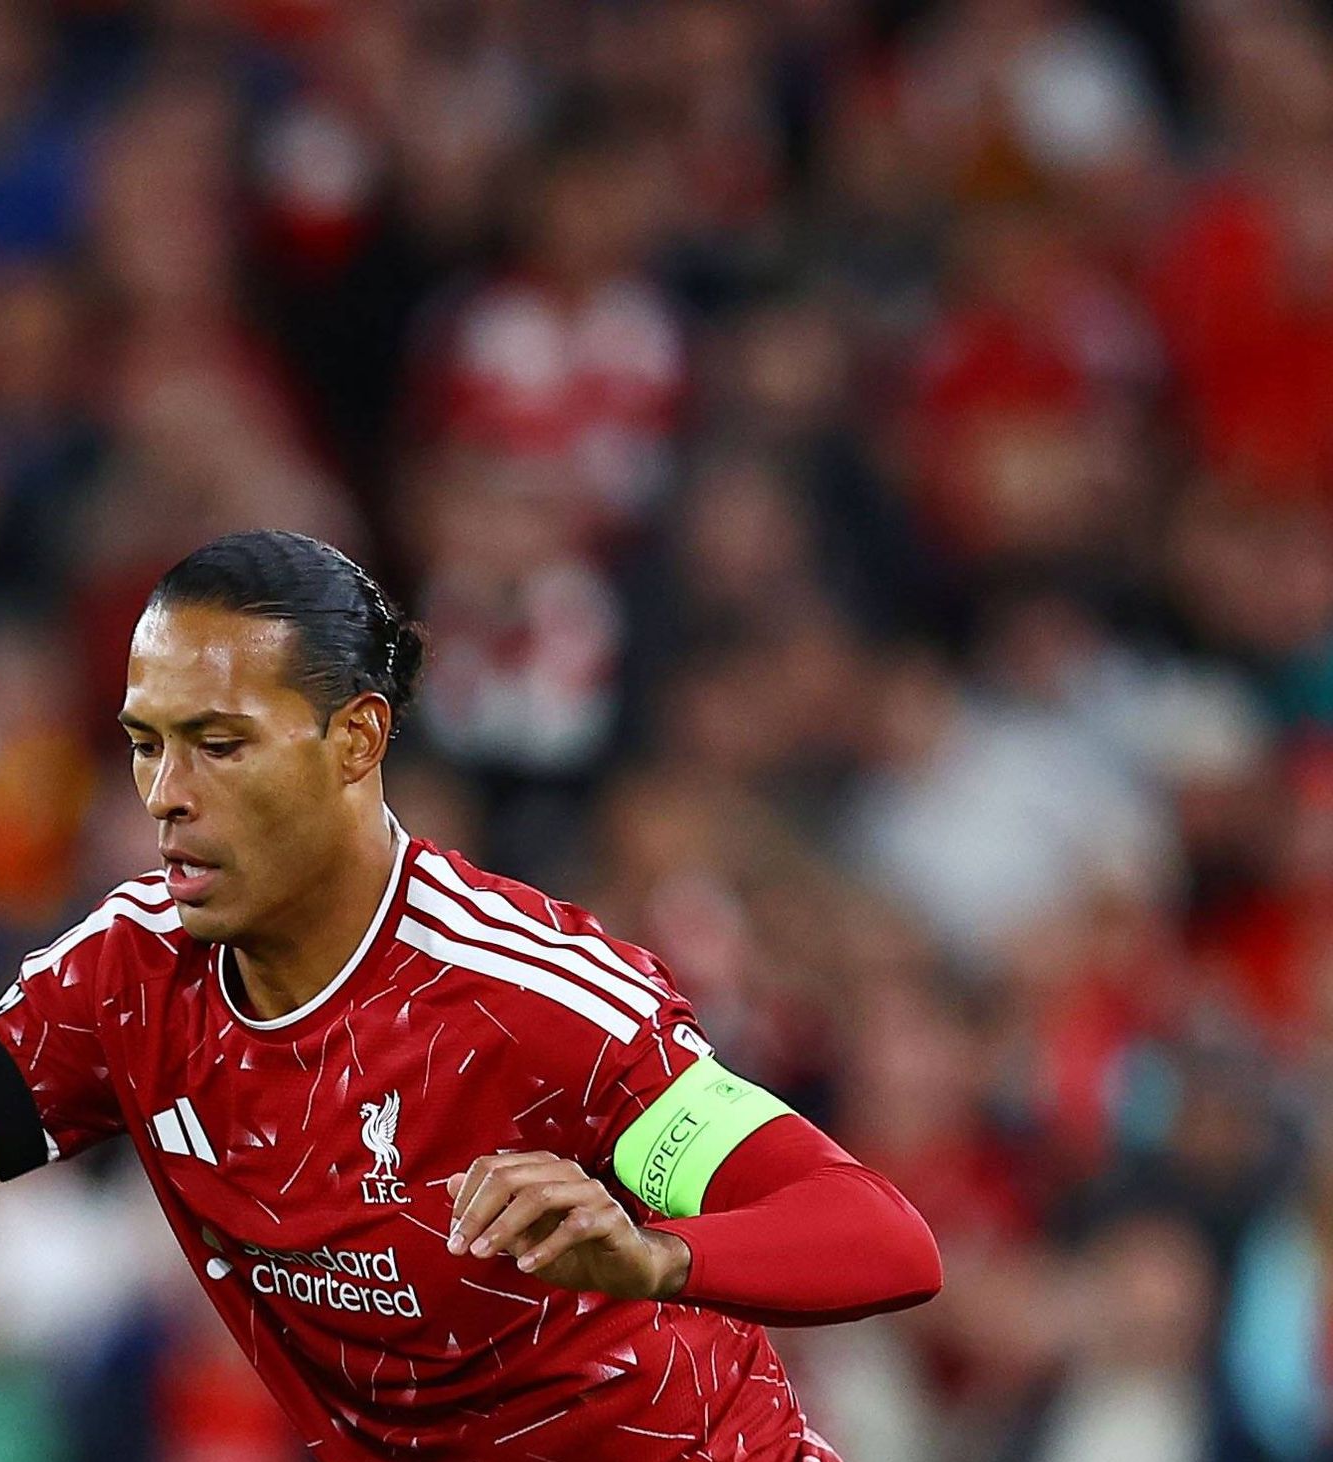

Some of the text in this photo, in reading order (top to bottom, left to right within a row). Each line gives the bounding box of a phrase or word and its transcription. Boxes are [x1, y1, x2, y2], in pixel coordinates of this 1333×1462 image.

[644, 1111, 699, 1213] RESPECT
[361, 1180, 413, 1204] L.F.C.
[251, 1260, 423, 1319] chartered
